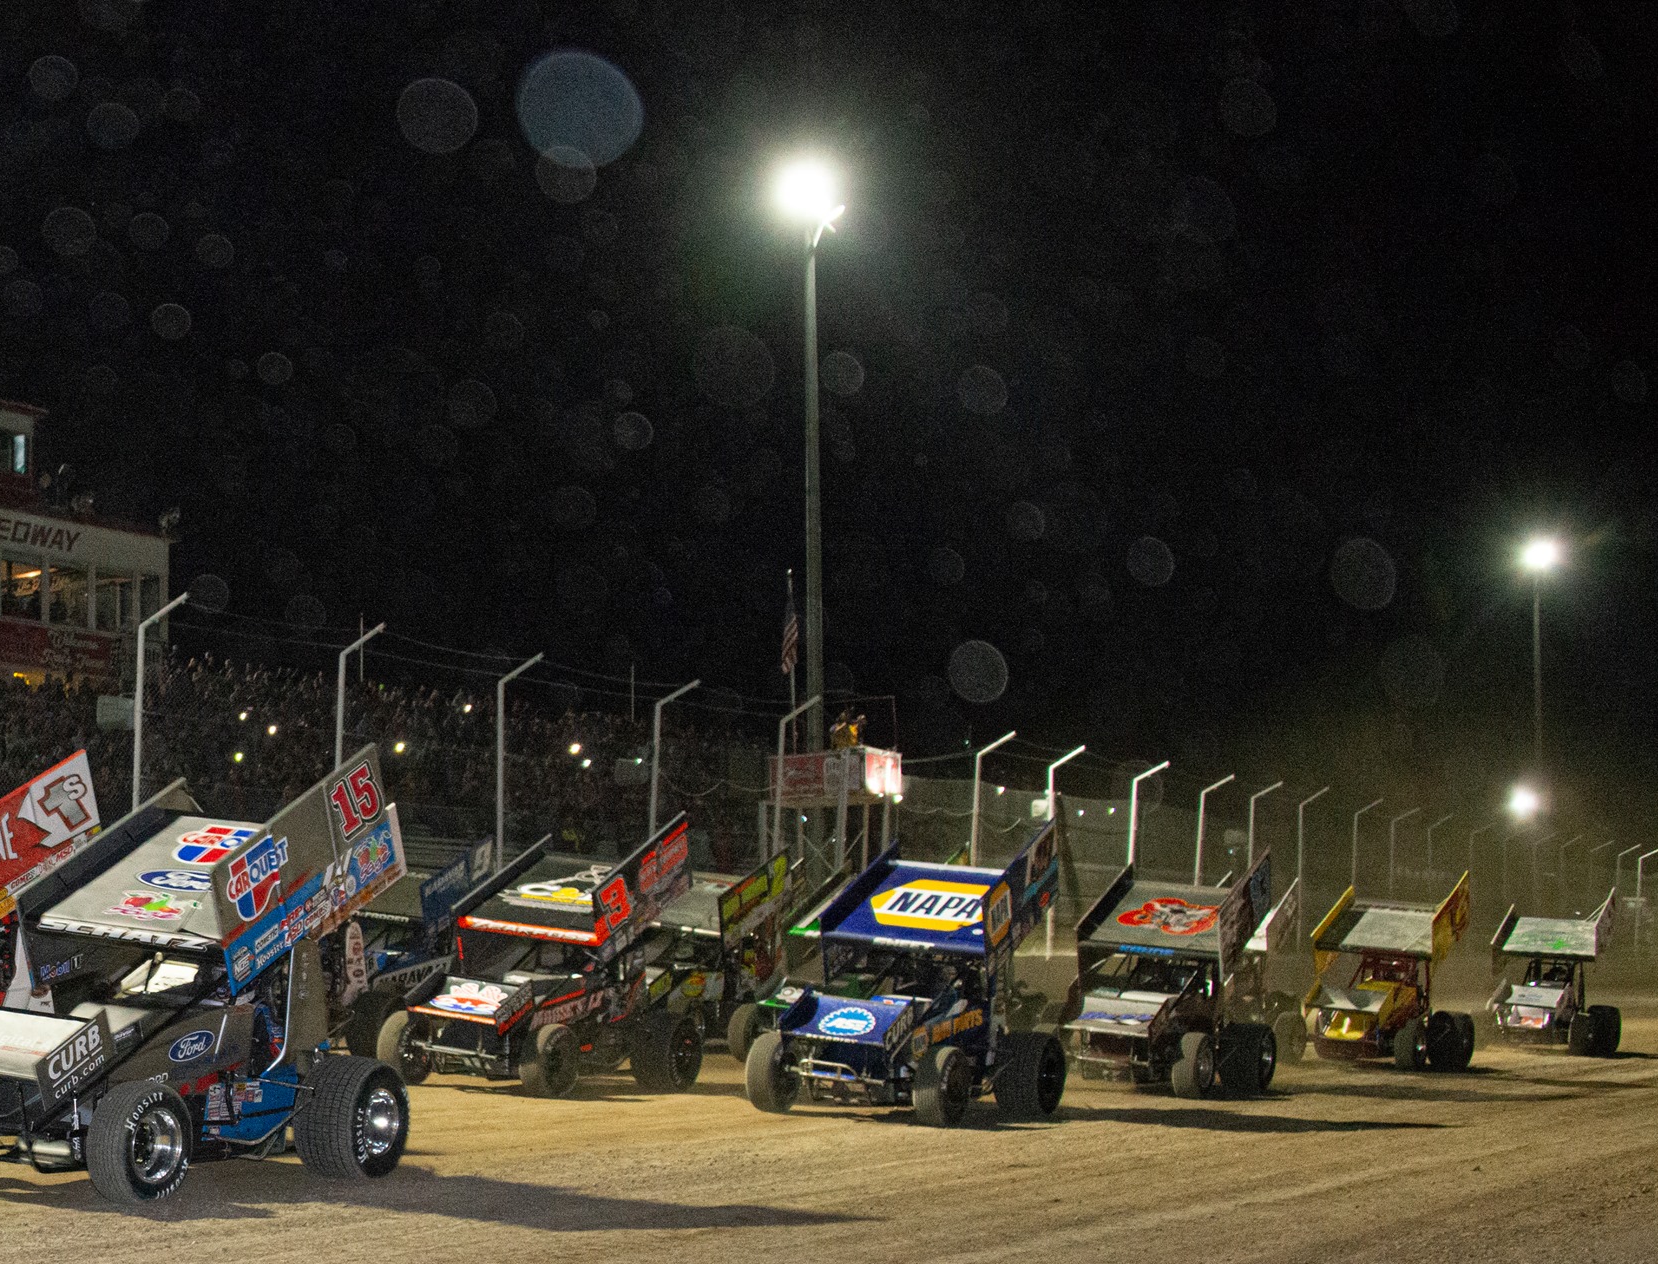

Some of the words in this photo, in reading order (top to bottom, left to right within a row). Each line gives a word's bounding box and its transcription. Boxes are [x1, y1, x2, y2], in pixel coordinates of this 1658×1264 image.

[331, 761, 380, 839] 15
[228, 839, 288, 900] CARQUEST
[889, 891, 982, 919] NAPA
[37, 918, 221, 952] SCHATZ
[255, 942, 288, 969] Hoosier
[40, 960, 70, 980] Mobil
[48, 1024, 100, 1080] CURB
[177, 1037, 207, 1059] Ford
[55, 1055, 105, 1099] curb.com
[124, 1091, 163, 1135] Hoosier
[357, 1107, 370, 1164] Hoosier
